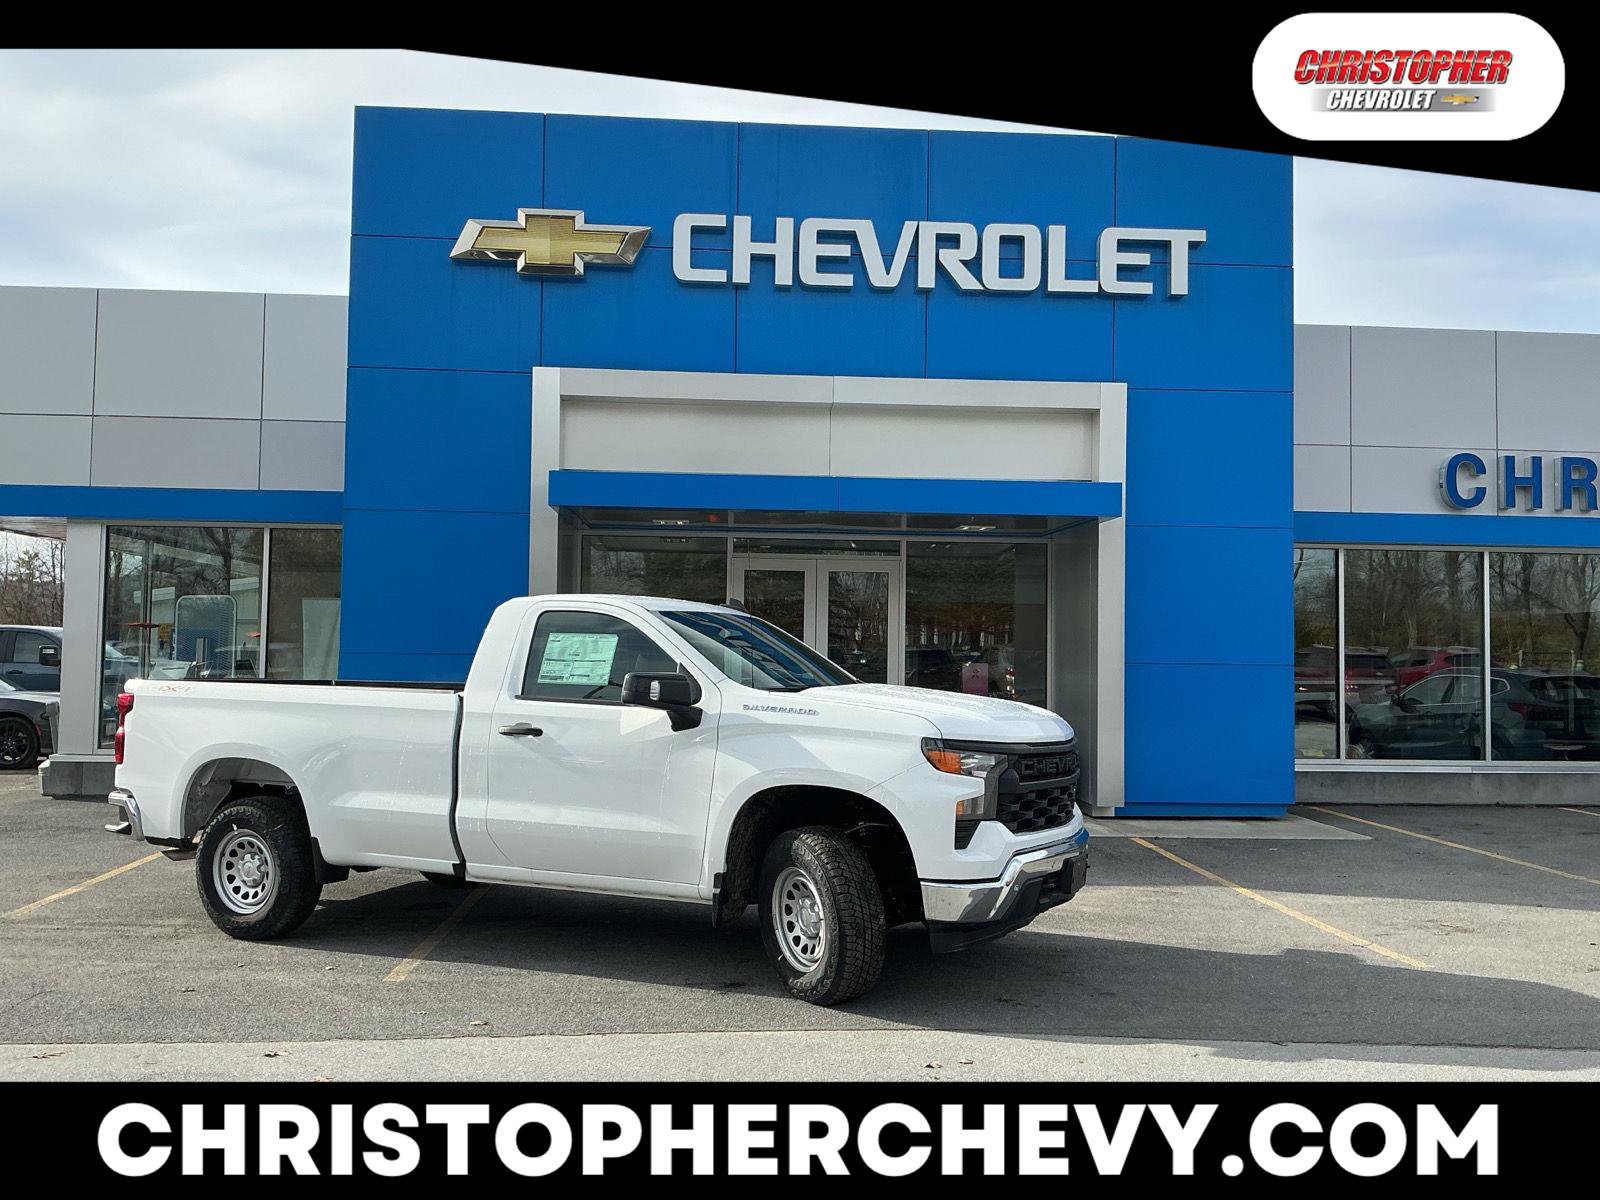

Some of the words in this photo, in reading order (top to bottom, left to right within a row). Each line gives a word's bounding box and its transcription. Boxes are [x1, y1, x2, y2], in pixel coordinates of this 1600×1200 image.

[672, 212, 1208, 298] CHEVROLET
[1440, 452, 1599, 512] CHR
[742, 704, 820, 716] SILVERADO
